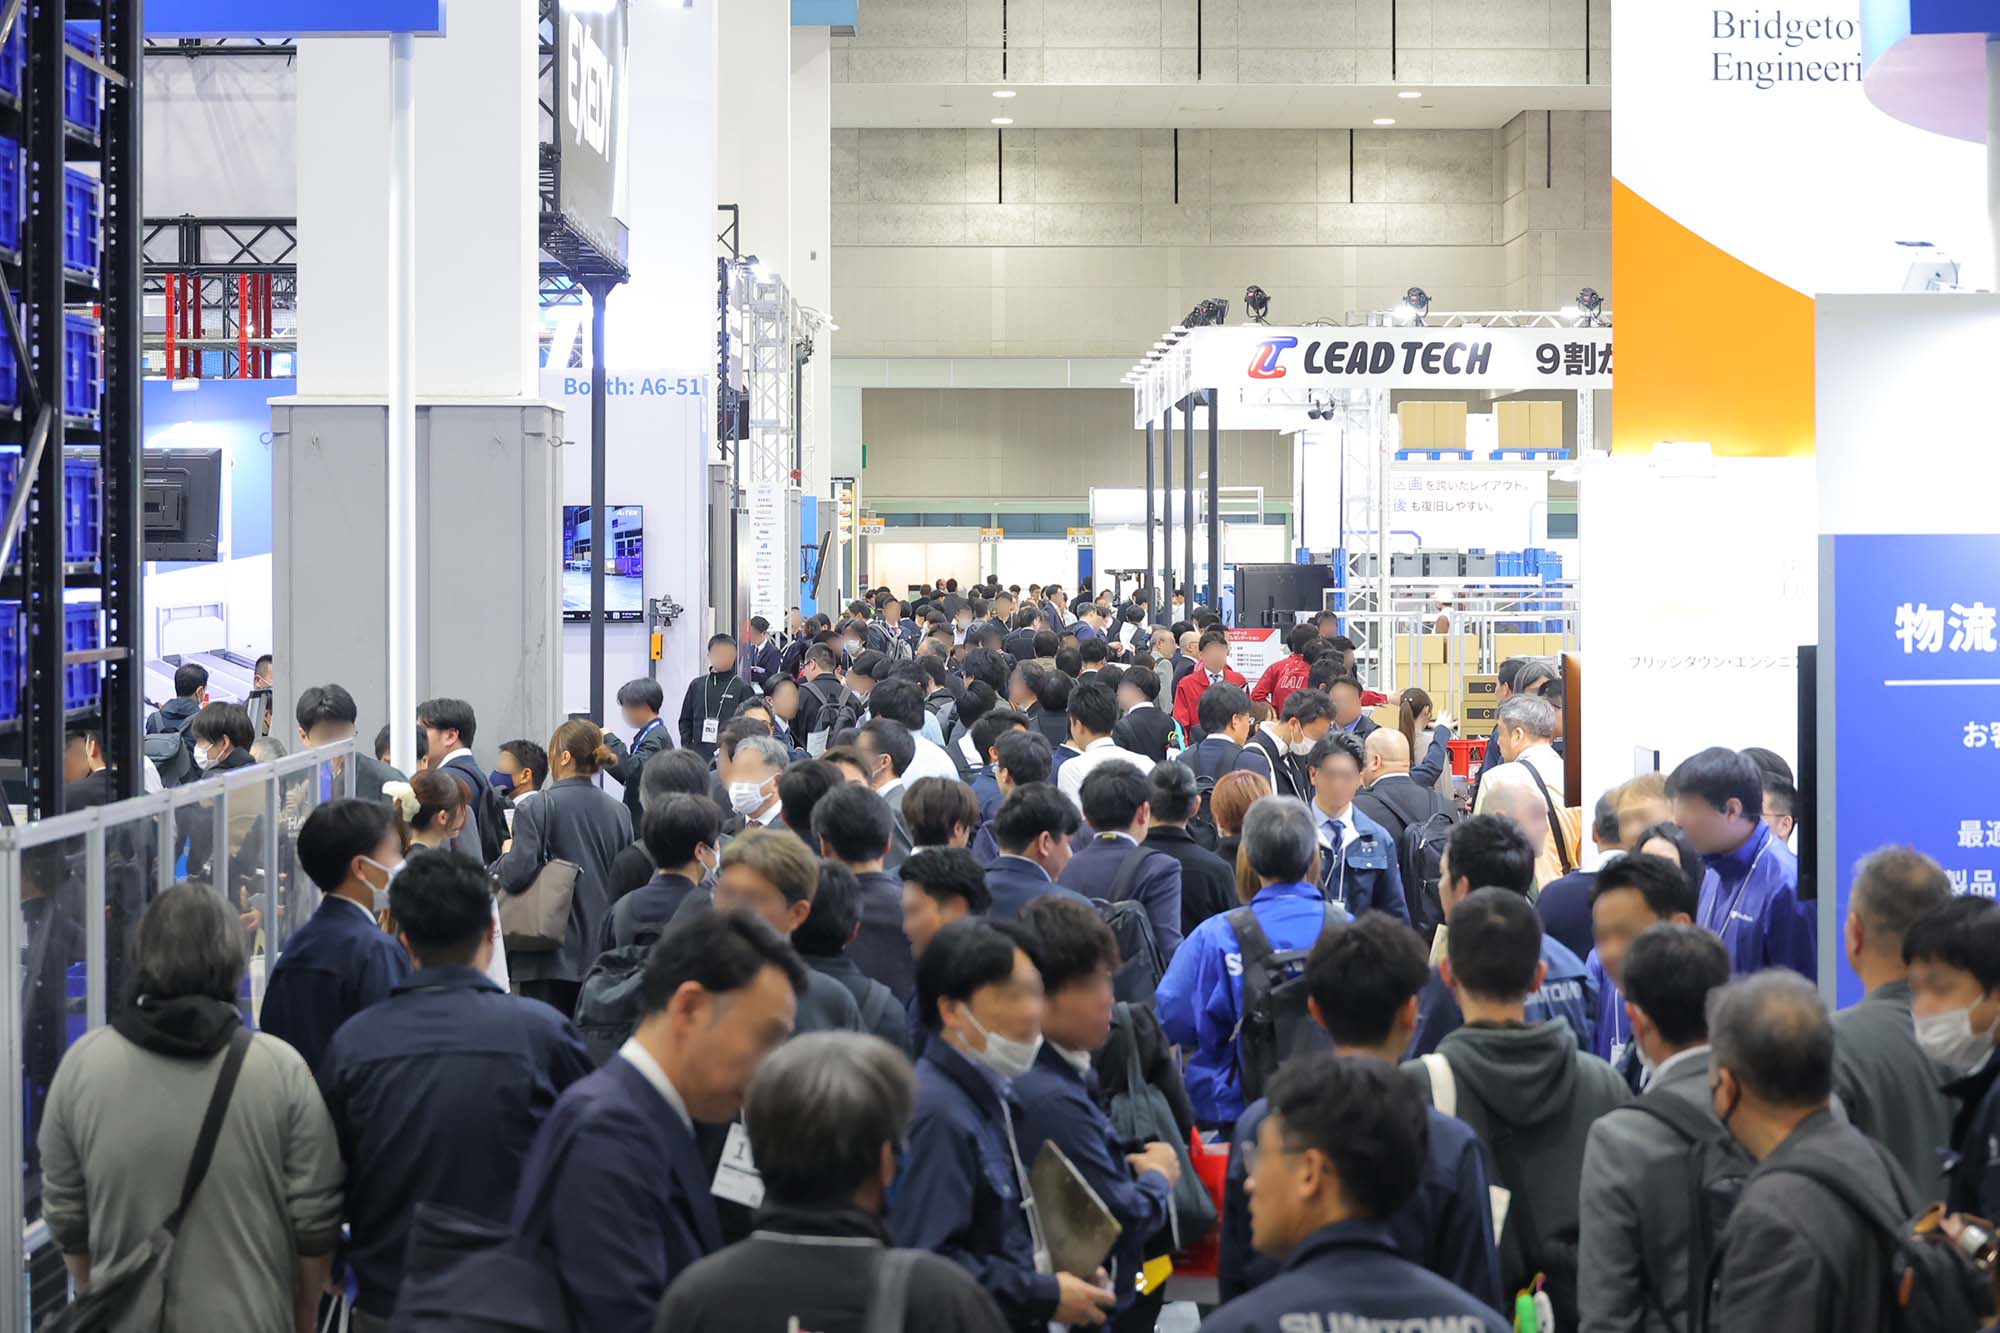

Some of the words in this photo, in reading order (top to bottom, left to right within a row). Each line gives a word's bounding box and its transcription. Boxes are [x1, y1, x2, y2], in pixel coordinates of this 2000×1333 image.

[1712, 9, 1860, 47] Bridgeto
[567, 13, 614, 162] EXEDY
[1304, 341, 1395, 374] LEAD
[1401, 341, 1492, 374] TECH
[564, 376, 634, 395] Both:
[640, 377, 701, 396] A6-51
[1894, 601, 2000, 654] 物流
[1944, 868, 2000, 898] 製品
